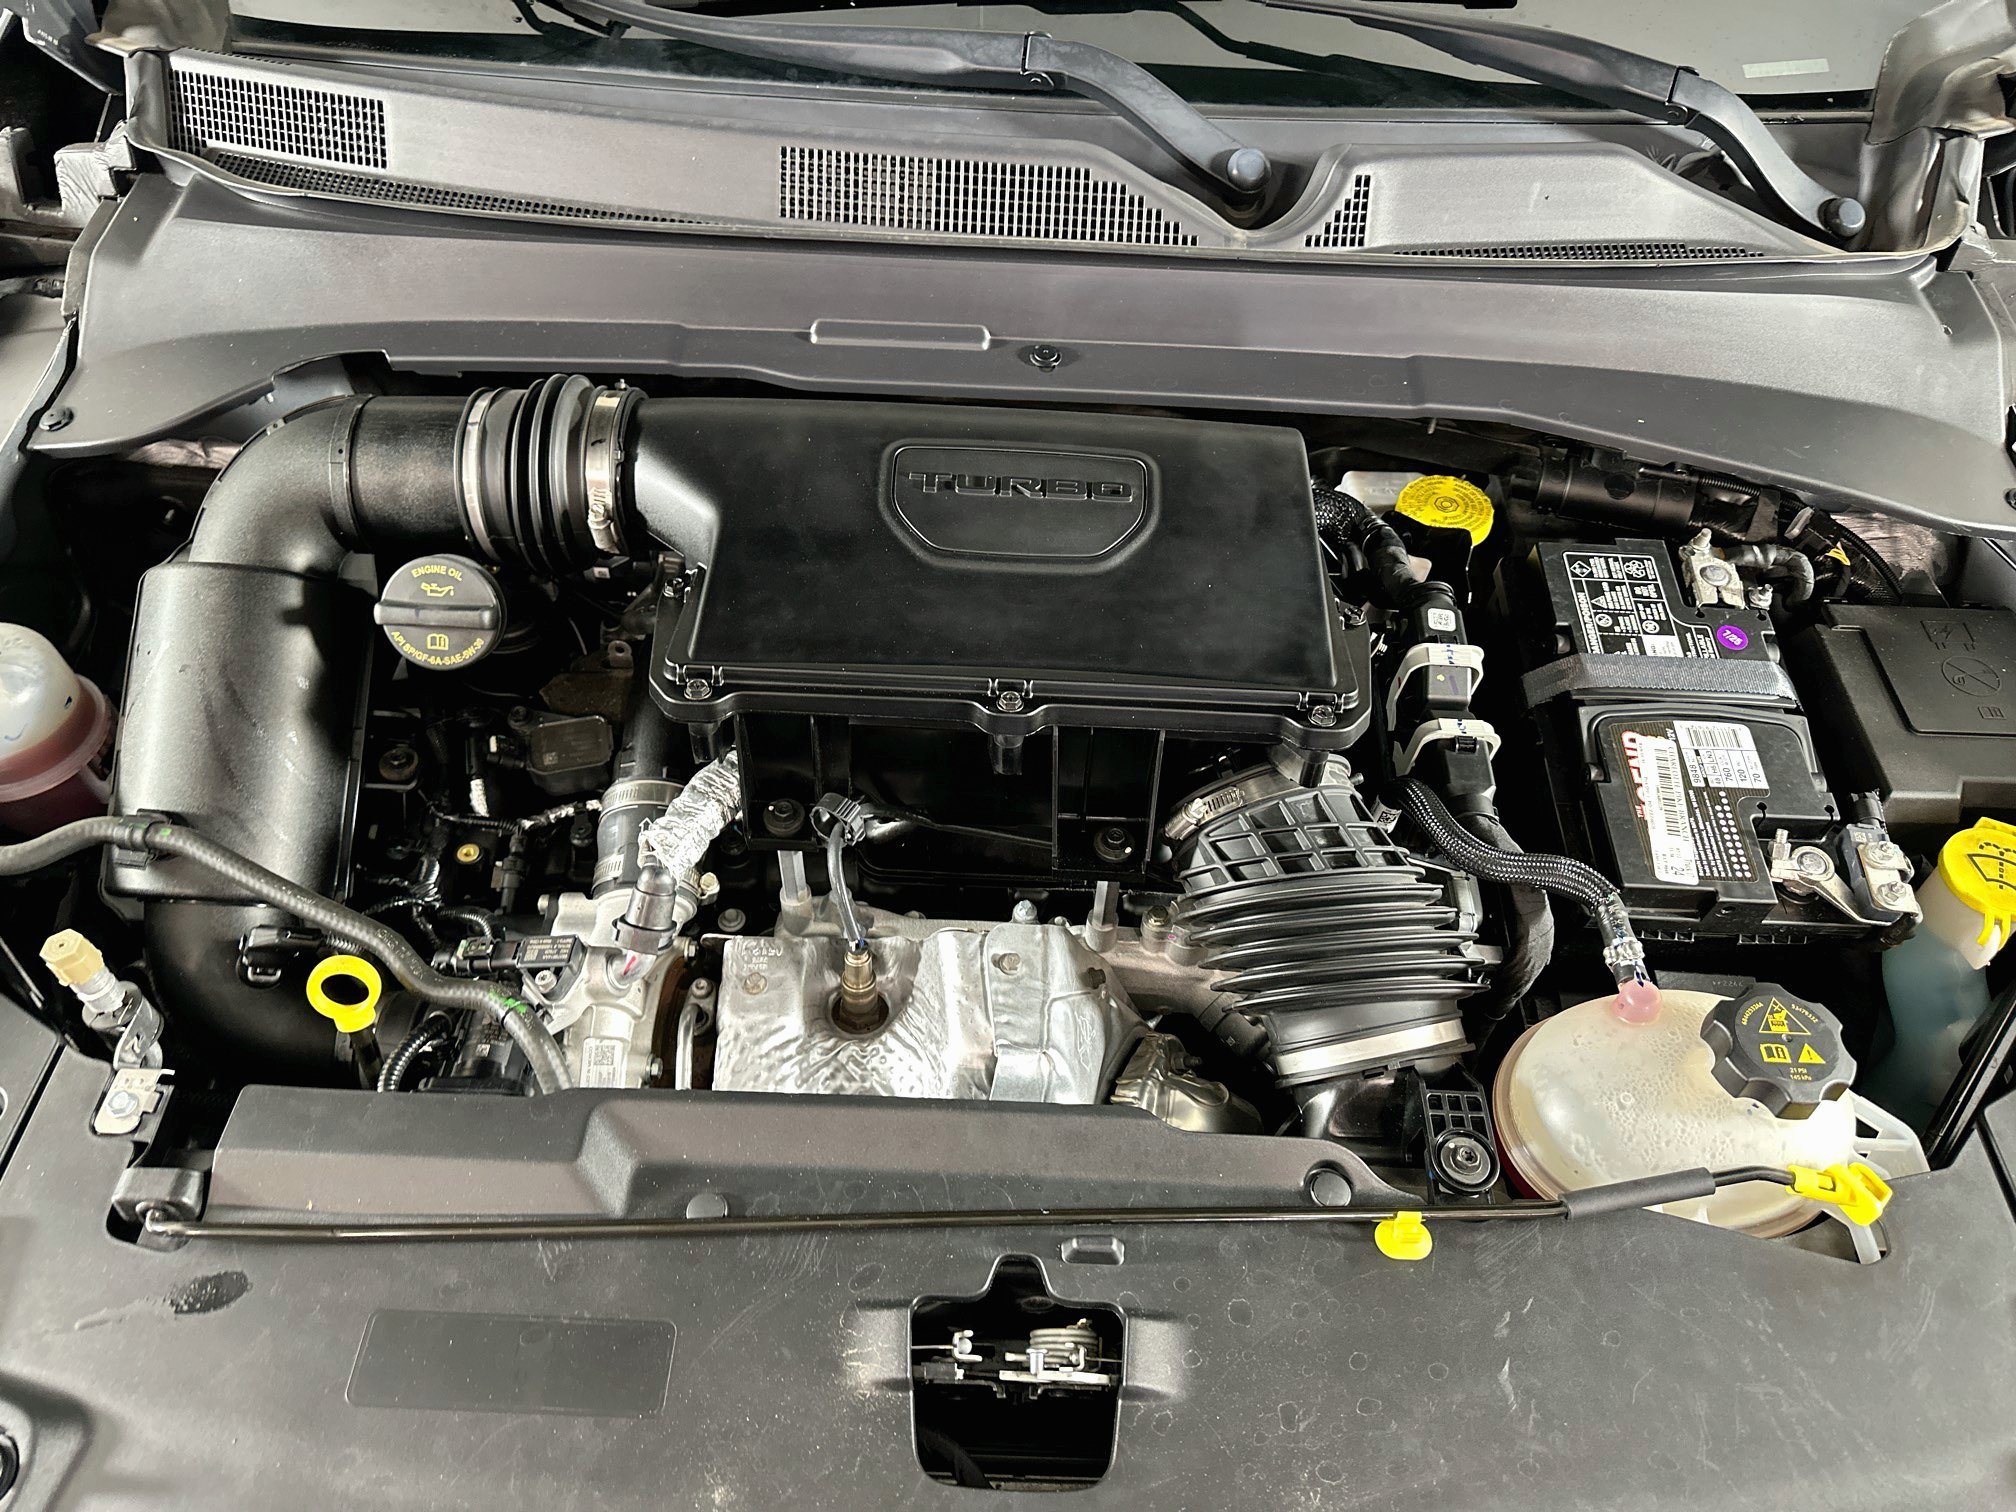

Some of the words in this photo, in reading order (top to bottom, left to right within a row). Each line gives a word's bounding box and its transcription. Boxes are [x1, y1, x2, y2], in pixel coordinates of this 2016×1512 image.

[909, 471, 1133, 502] TURBO
[411, 565, 447, 578] ENGINE
[448, 566, 463, 582] OIL
[391, 630, 405, 646] API
[1706, 750, 1714, 762] LN3
[1688, 764, 1701, 783] 9848
[1722, 767, 1733, 781] 760
[1736, 769, 1747, 781] 120
[1751, 773, 1762, 782] 70
[1670, 865, 1684, 876] 24
